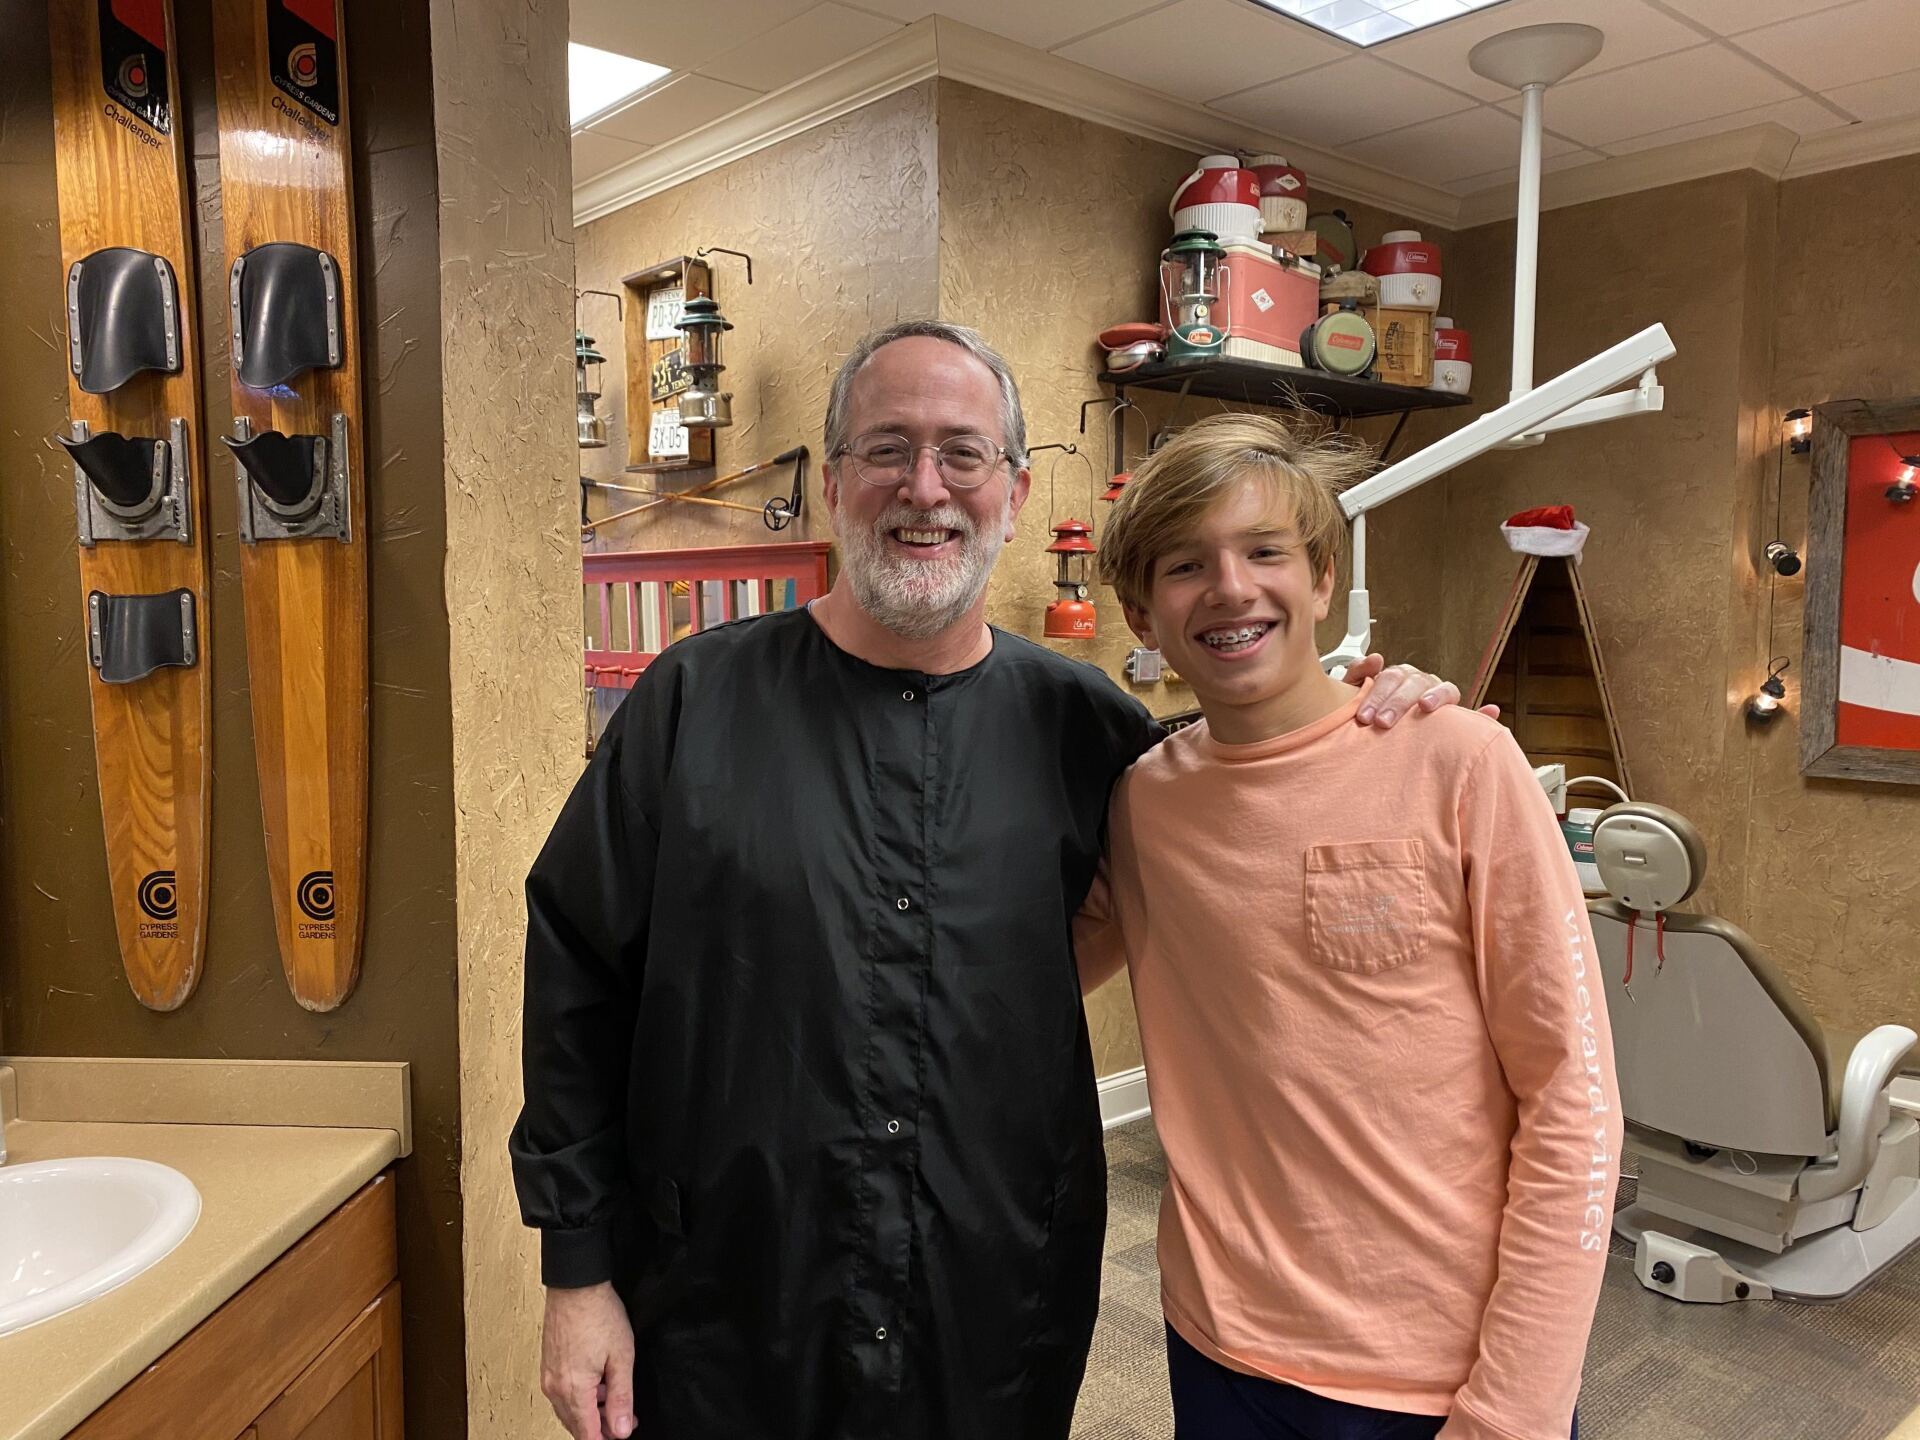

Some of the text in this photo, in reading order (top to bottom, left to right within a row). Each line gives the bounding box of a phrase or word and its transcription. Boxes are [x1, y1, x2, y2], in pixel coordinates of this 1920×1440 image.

[304, 96, 337, 121] GARDENS
[104, 103, 162, 149] Challenger
[271, 96, 332, 142] Challenger
[139, 923, 179, 931] CYPRESS
[139, 931, 179, 939] GARDENS
[298, 923, 336, 931] CYPRESS
[298, 931, 337, 939] GARDENS
[1563, 907, 1614, 1252] vineyard vines
